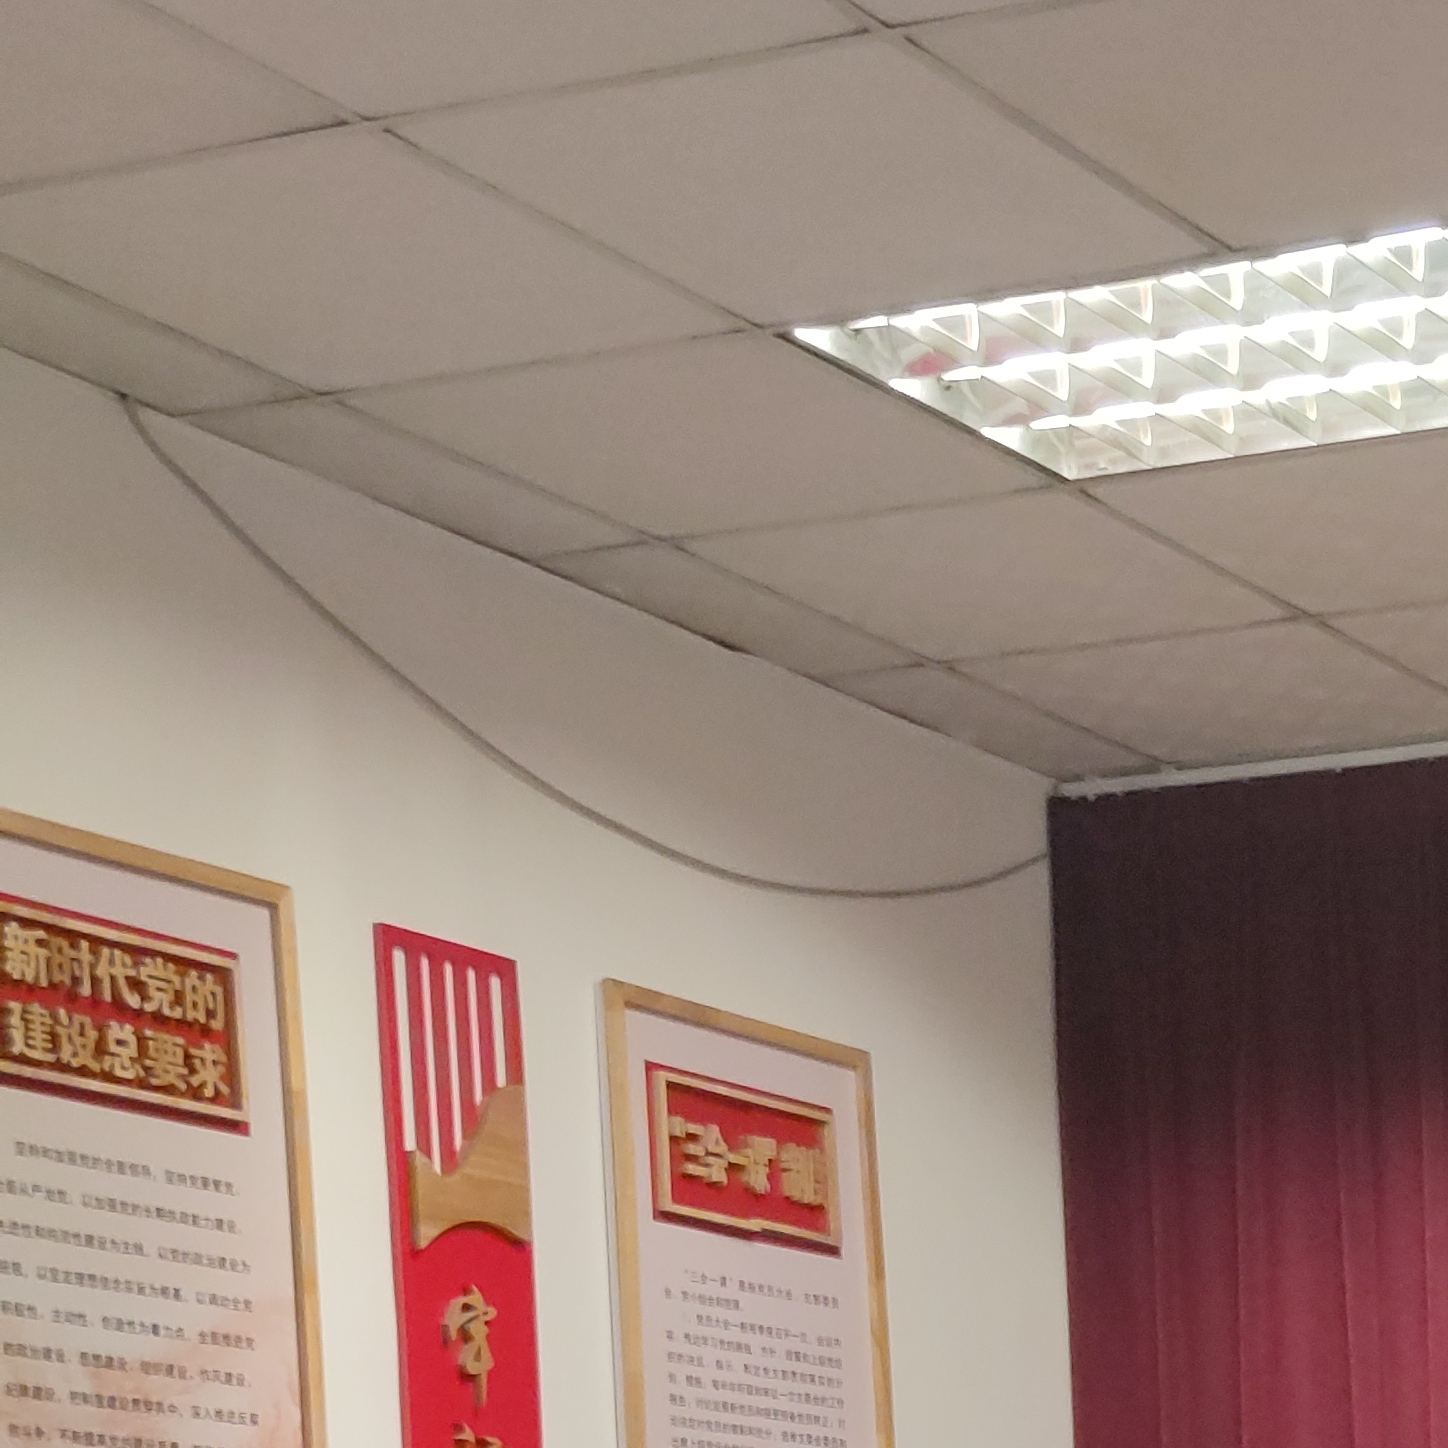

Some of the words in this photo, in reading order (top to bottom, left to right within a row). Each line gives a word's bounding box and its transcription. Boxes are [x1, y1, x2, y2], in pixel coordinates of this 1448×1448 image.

[2, 921, 226, 1031] 新时代党的
[2, 1003, 230, 1099] 建设总要求
